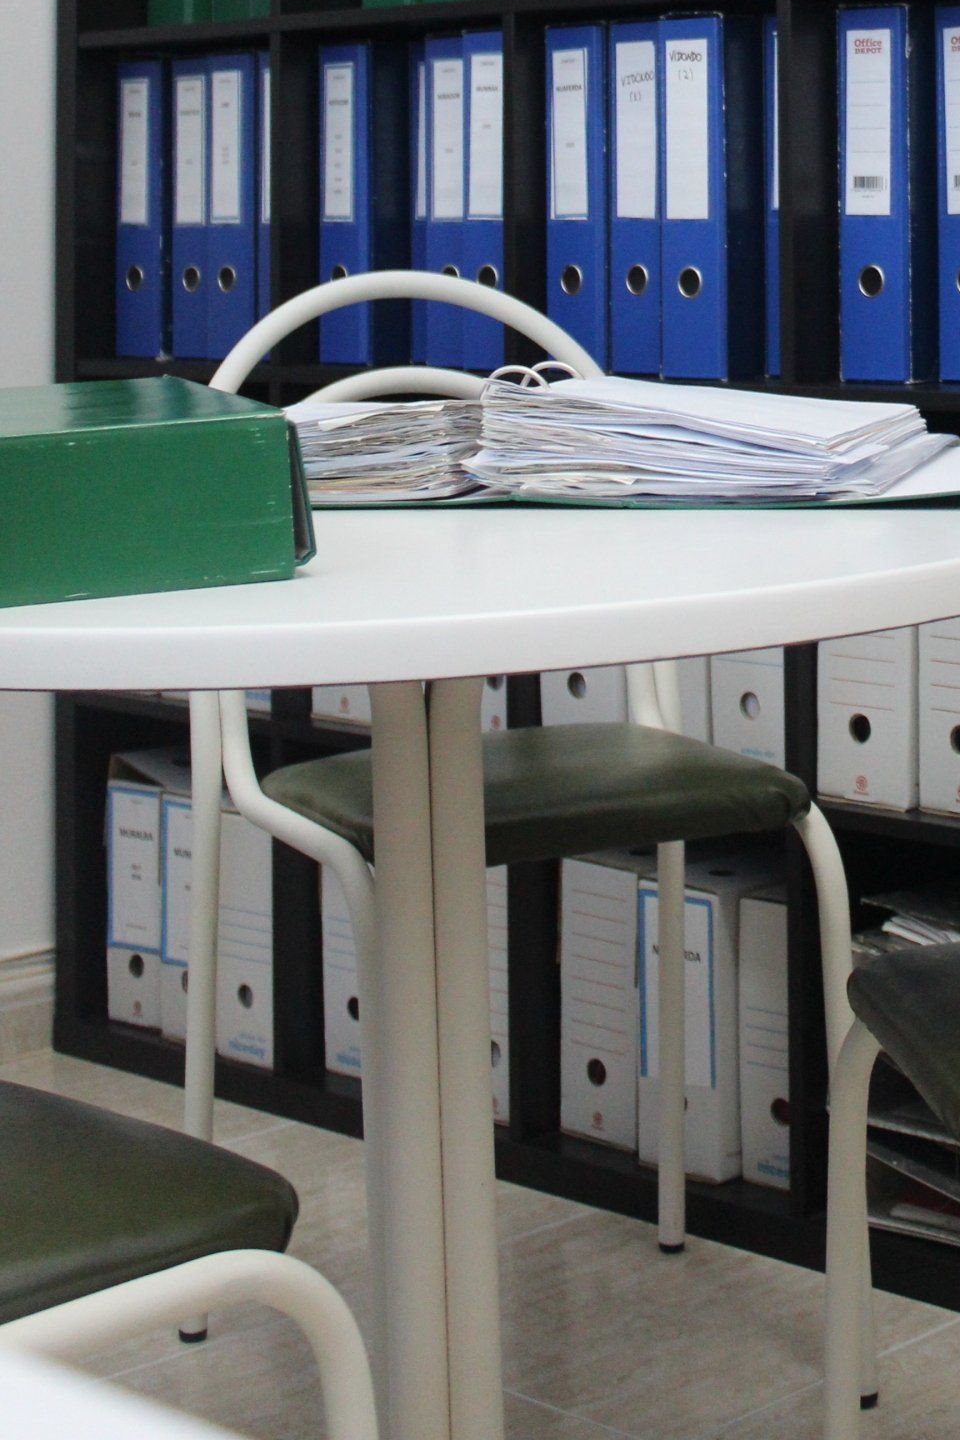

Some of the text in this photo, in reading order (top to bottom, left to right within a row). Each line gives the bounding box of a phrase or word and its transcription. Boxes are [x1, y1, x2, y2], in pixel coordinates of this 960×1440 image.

[854, 38, 882, 48] Office
[854, 47, 882, 55] DEPOT
[669, 51, 702, 63] VIDONDO
[678, 68, 694, 81] (2)
